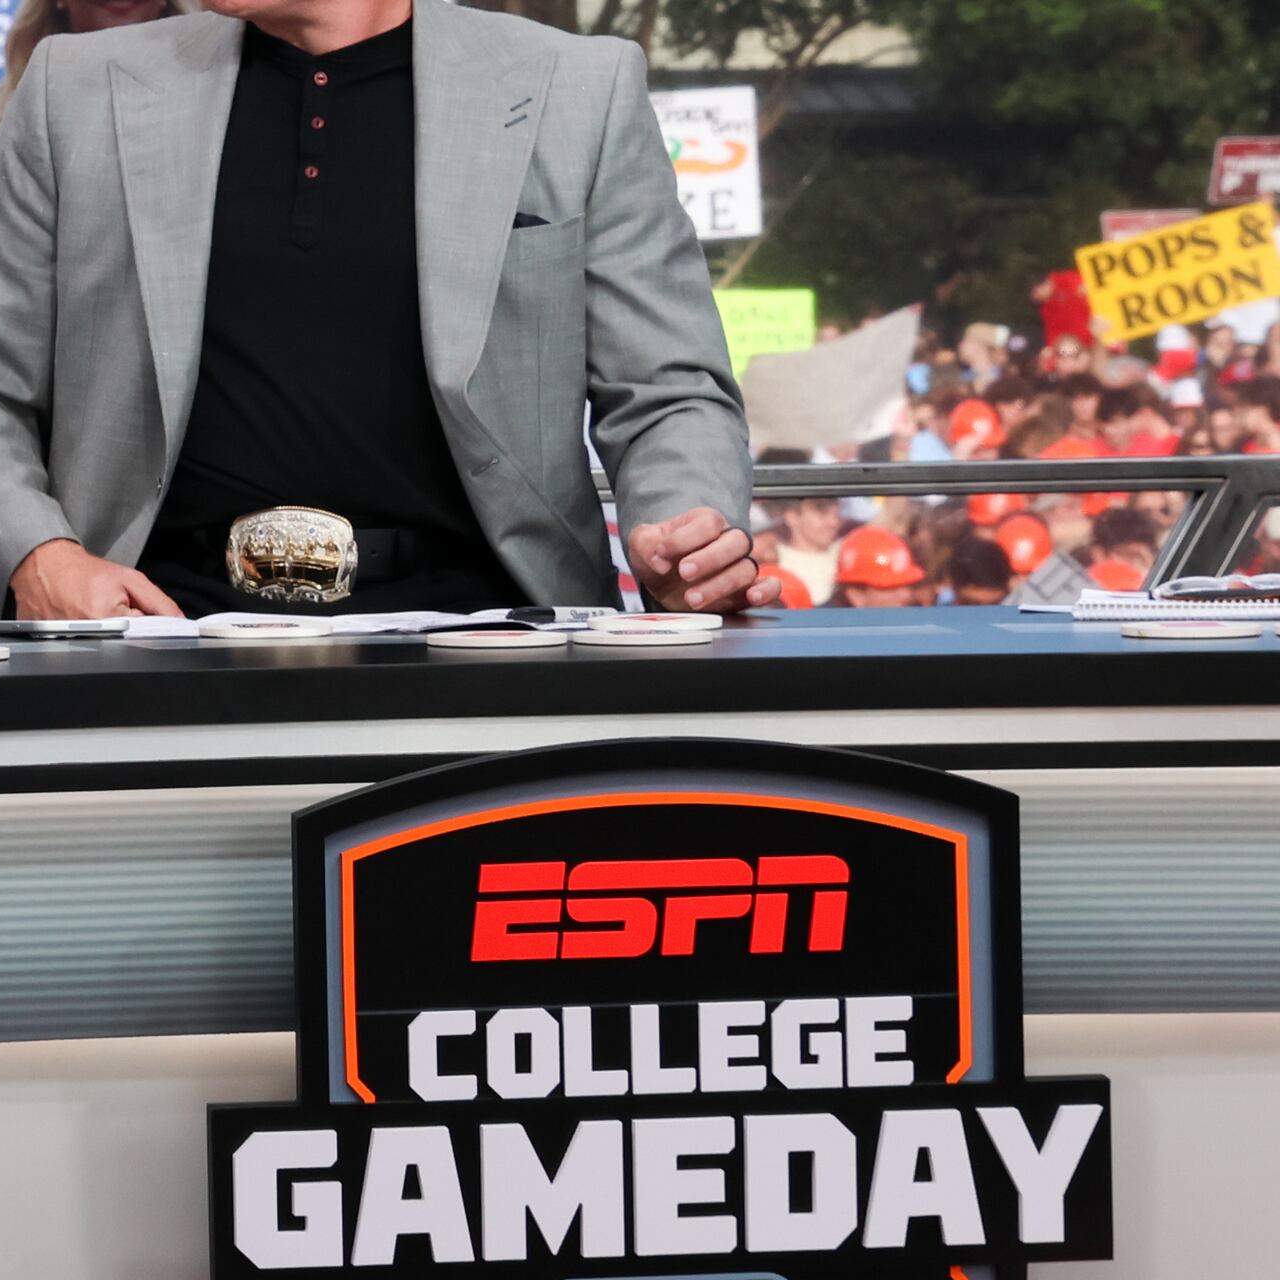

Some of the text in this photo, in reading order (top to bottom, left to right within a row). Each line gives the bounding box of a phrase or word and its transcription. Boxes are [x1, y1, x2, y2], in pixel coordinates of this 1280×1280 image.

[1088, 212, 1268, 288] POPS &
[1117, 259, 1265, 329] ROON
[470, 854, 851, 962] ESPN
[407, 995, 914, 1102] COLLEGE
[231, 1103, 1104, 1270] GAMEDAY
